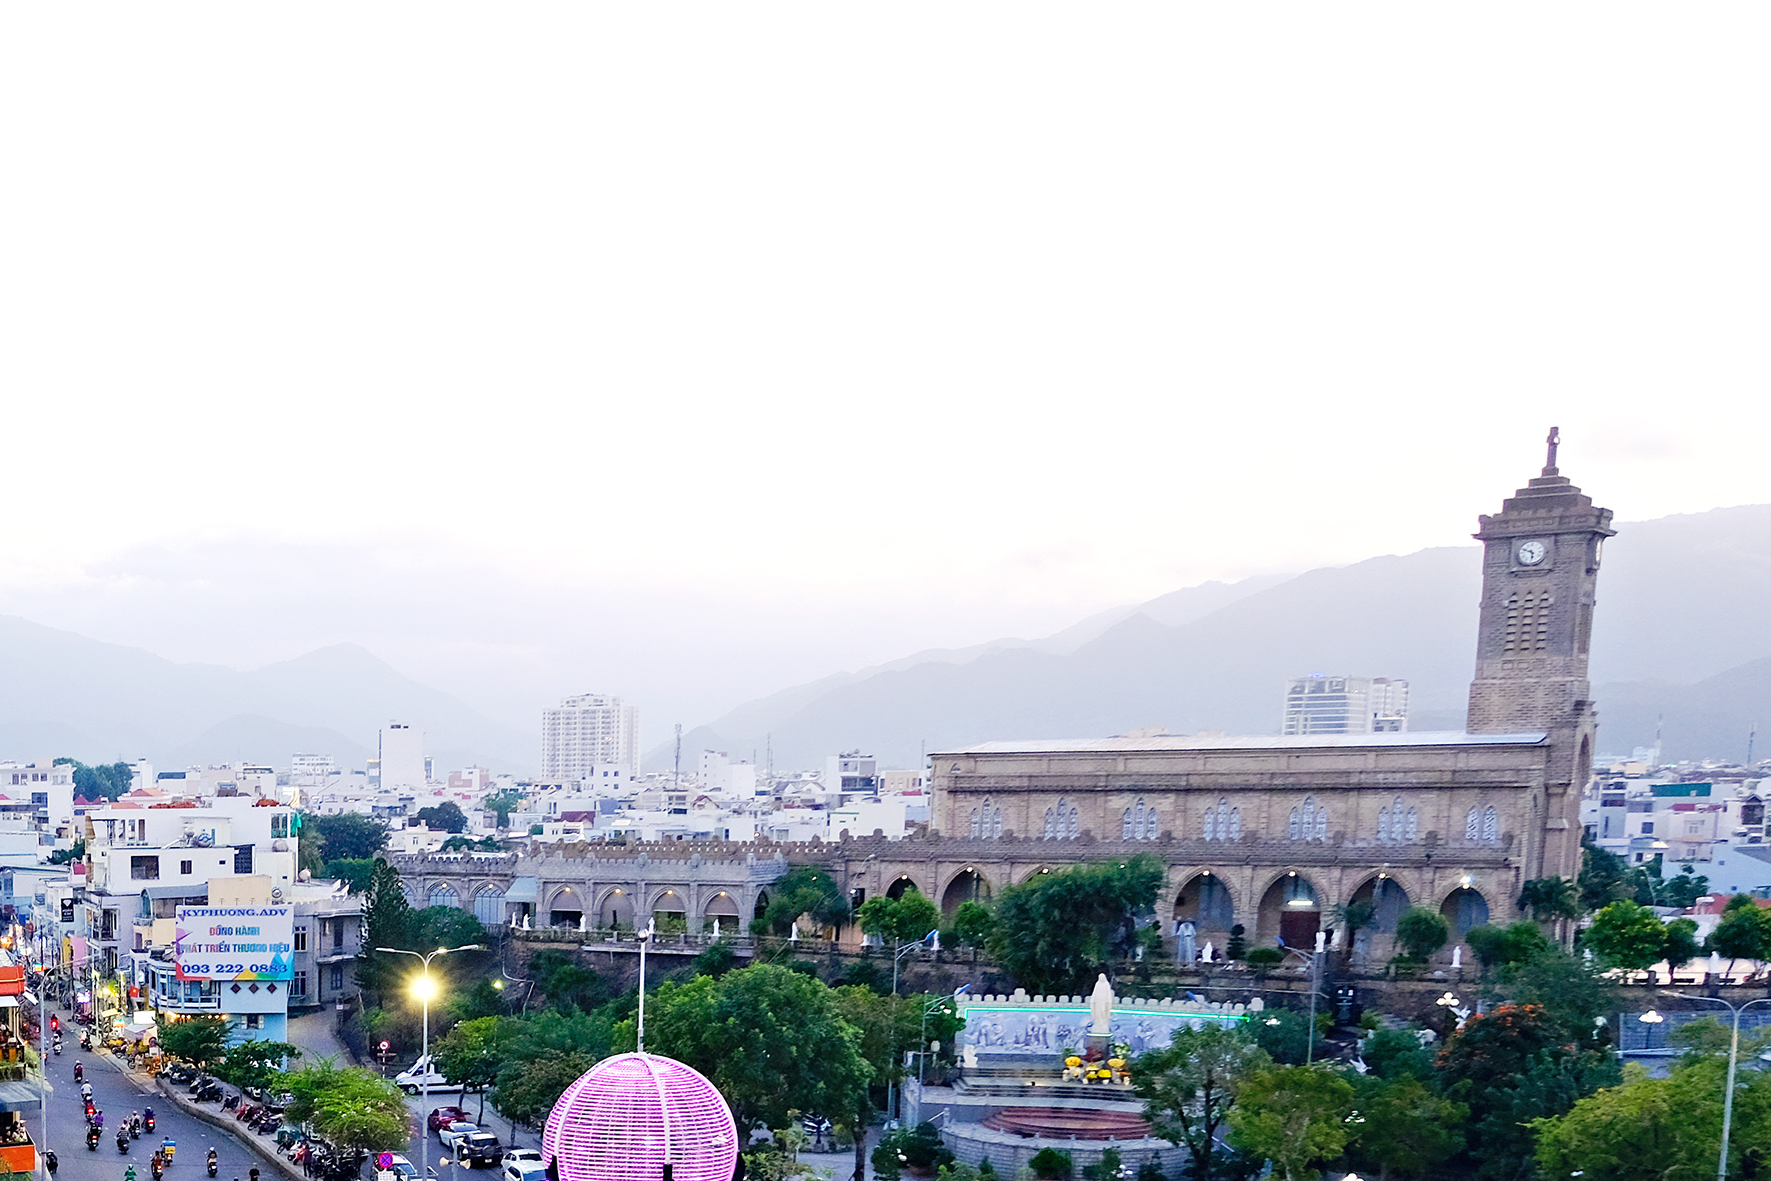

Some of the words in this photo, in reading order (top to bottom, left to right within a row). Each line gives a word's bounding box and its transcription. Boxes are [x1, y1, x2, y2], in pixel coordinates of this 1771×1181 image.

[182, 963, 210, 974] 093
[215, 963, 244, 974] 222
[249, 963, 288, 974] 0883
